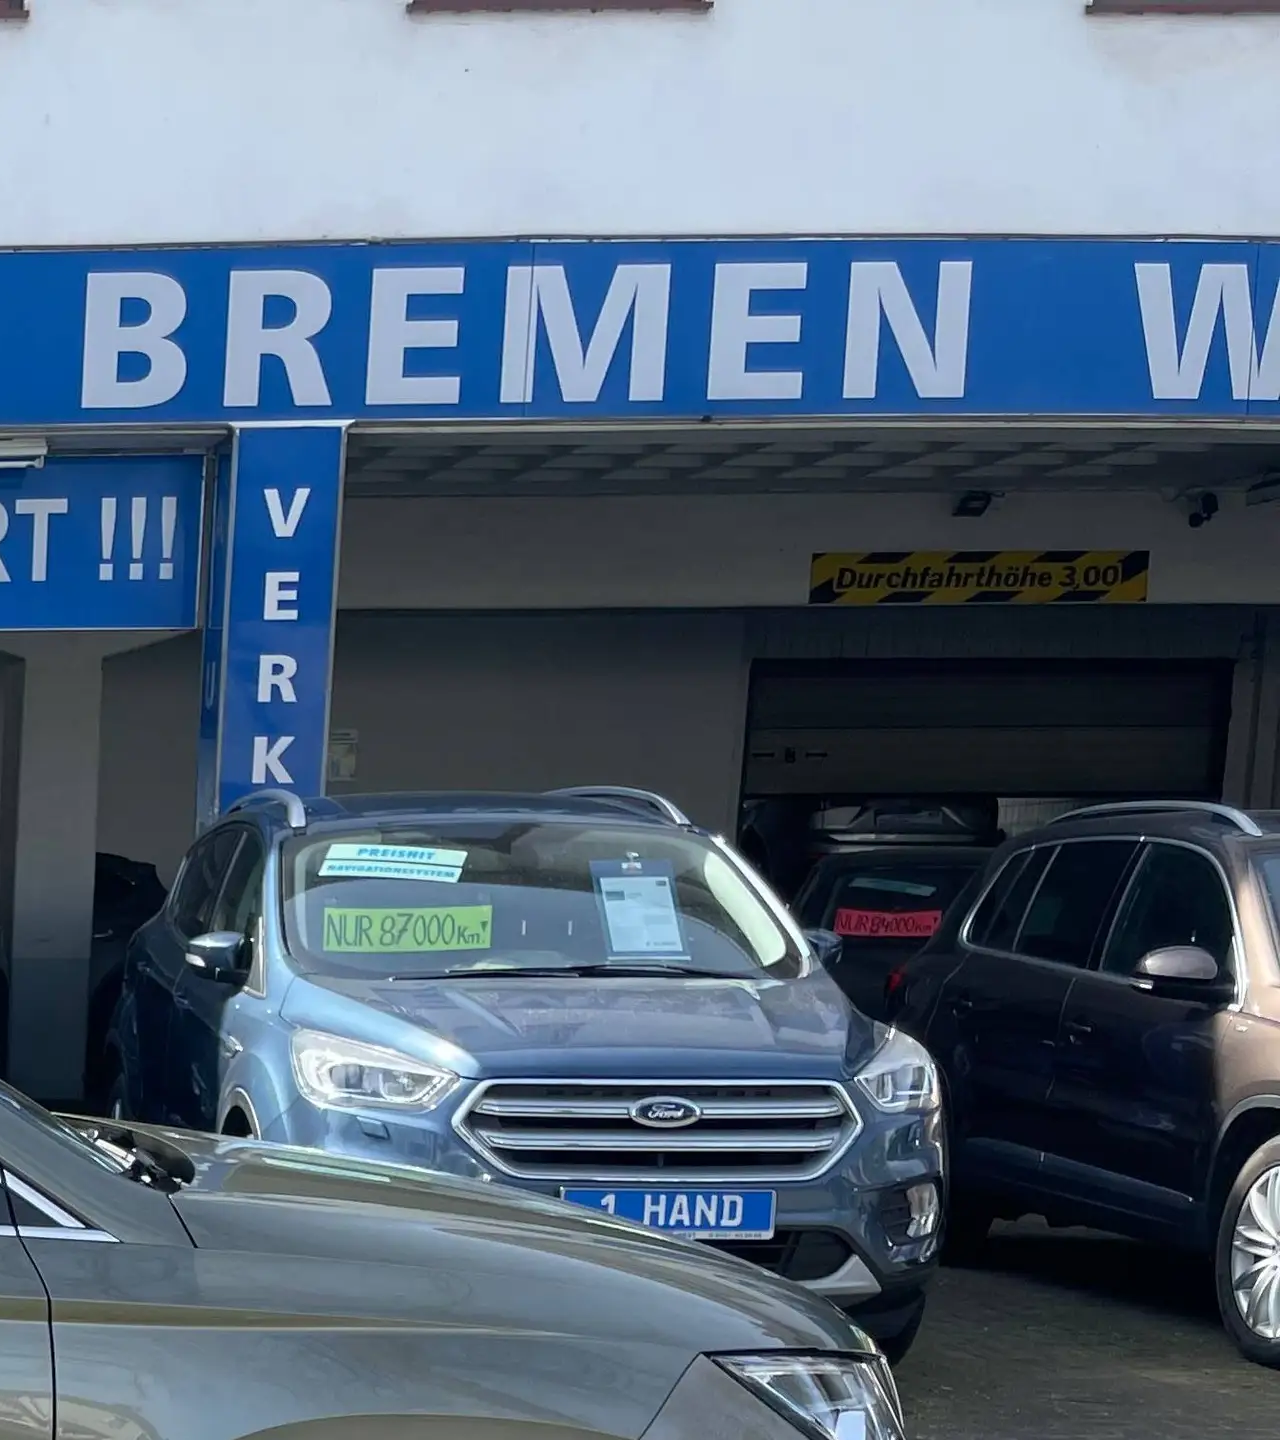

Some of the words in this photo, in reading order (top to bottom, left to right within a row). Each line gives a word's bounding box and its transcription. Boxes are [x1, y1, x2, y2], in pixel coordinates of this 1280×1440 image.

[81, 260, 973, 410] BREMEN
[1134, 262, 1280, 401] W
[99, 496, 178, 582] !!!
[837, 565, 1052, 590] Durchfahrthöhe
[1059, 565, 1122, 591] 3,00
[326, 913, 373, 948] NUR
[647, 1103, 685, 1120] Ford
[600, 1193, 616, 1216] 1
[643, 1193, 744, 1227] HAND
